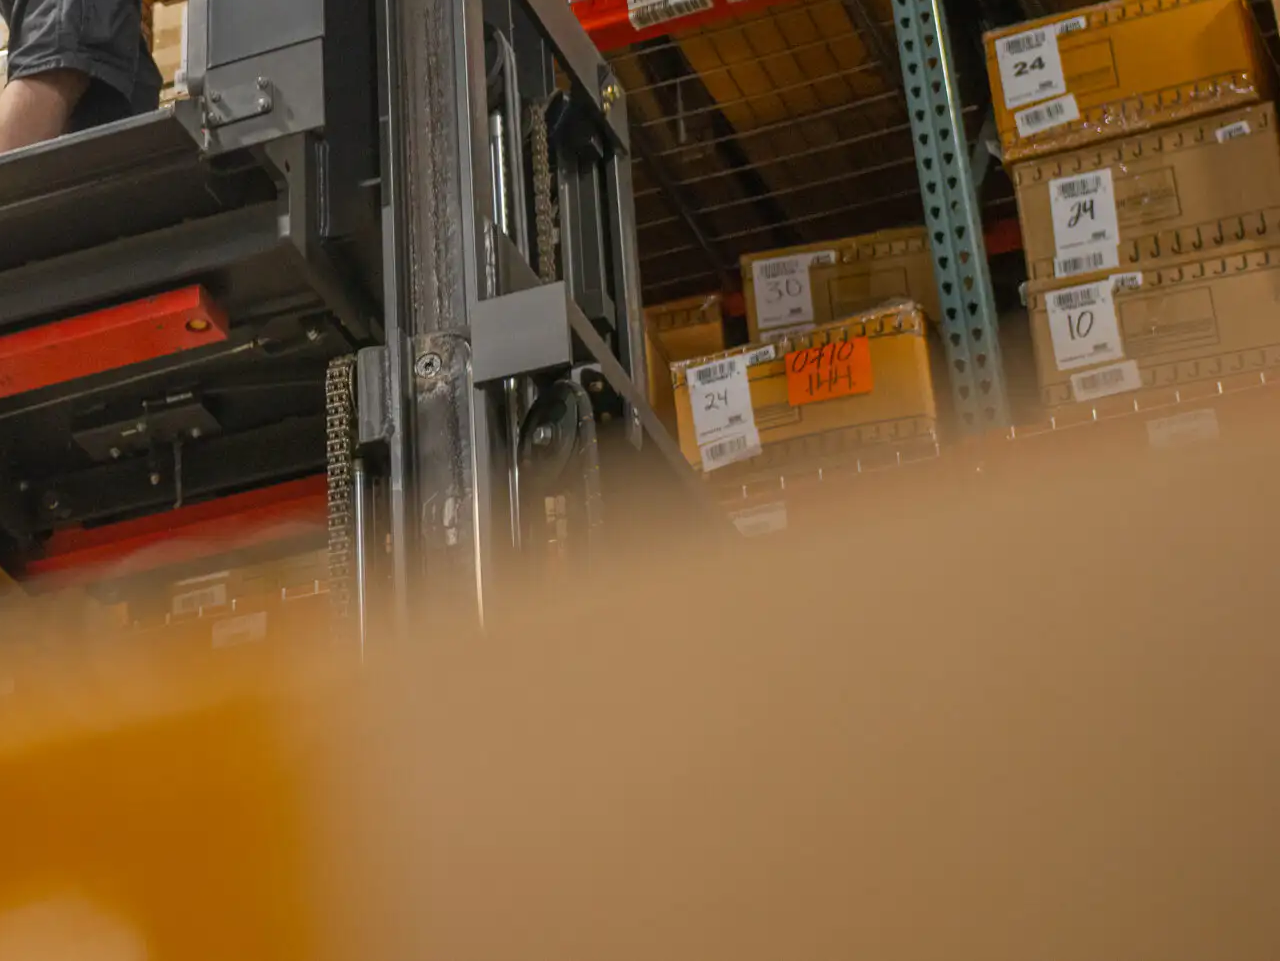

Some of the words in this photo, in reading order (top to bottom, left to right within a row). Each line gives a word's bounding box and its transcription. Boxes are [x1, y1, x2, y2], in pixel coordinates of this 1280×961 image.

[1012, 56, 1046, 78] 24
[1067, 198, 1095, 228] 24
[1067, 310, 1094, 341] 10
[704, 389, 729, 411] 24
